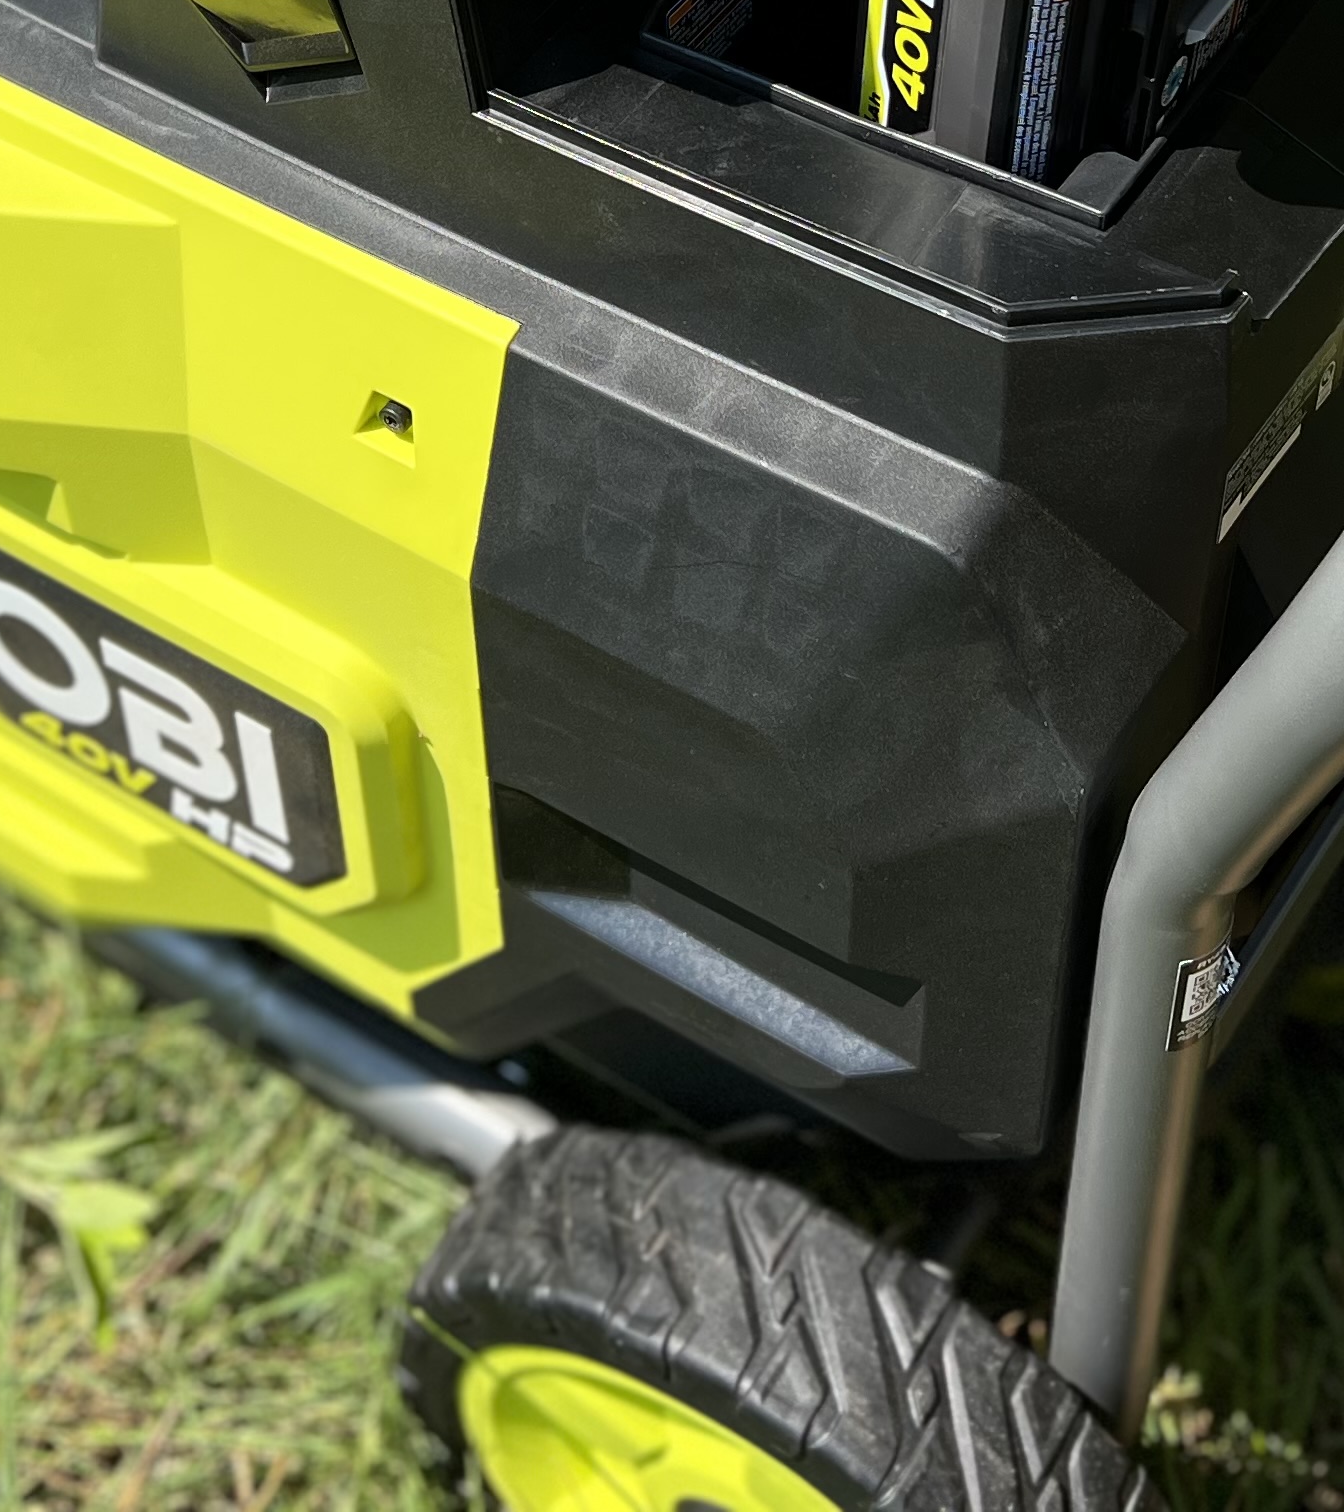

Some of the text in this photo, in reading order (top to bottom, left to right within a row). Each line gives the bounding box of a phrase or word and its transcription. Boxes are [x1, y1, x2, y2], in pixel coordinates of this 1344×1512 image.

[982, 698, 1032, 742] 4Ah
[1031, 660, 1161, 768] RYOBI
[1143, 726, 1174, 760] 40V
[19, 710, 295, 875] 40V HP
